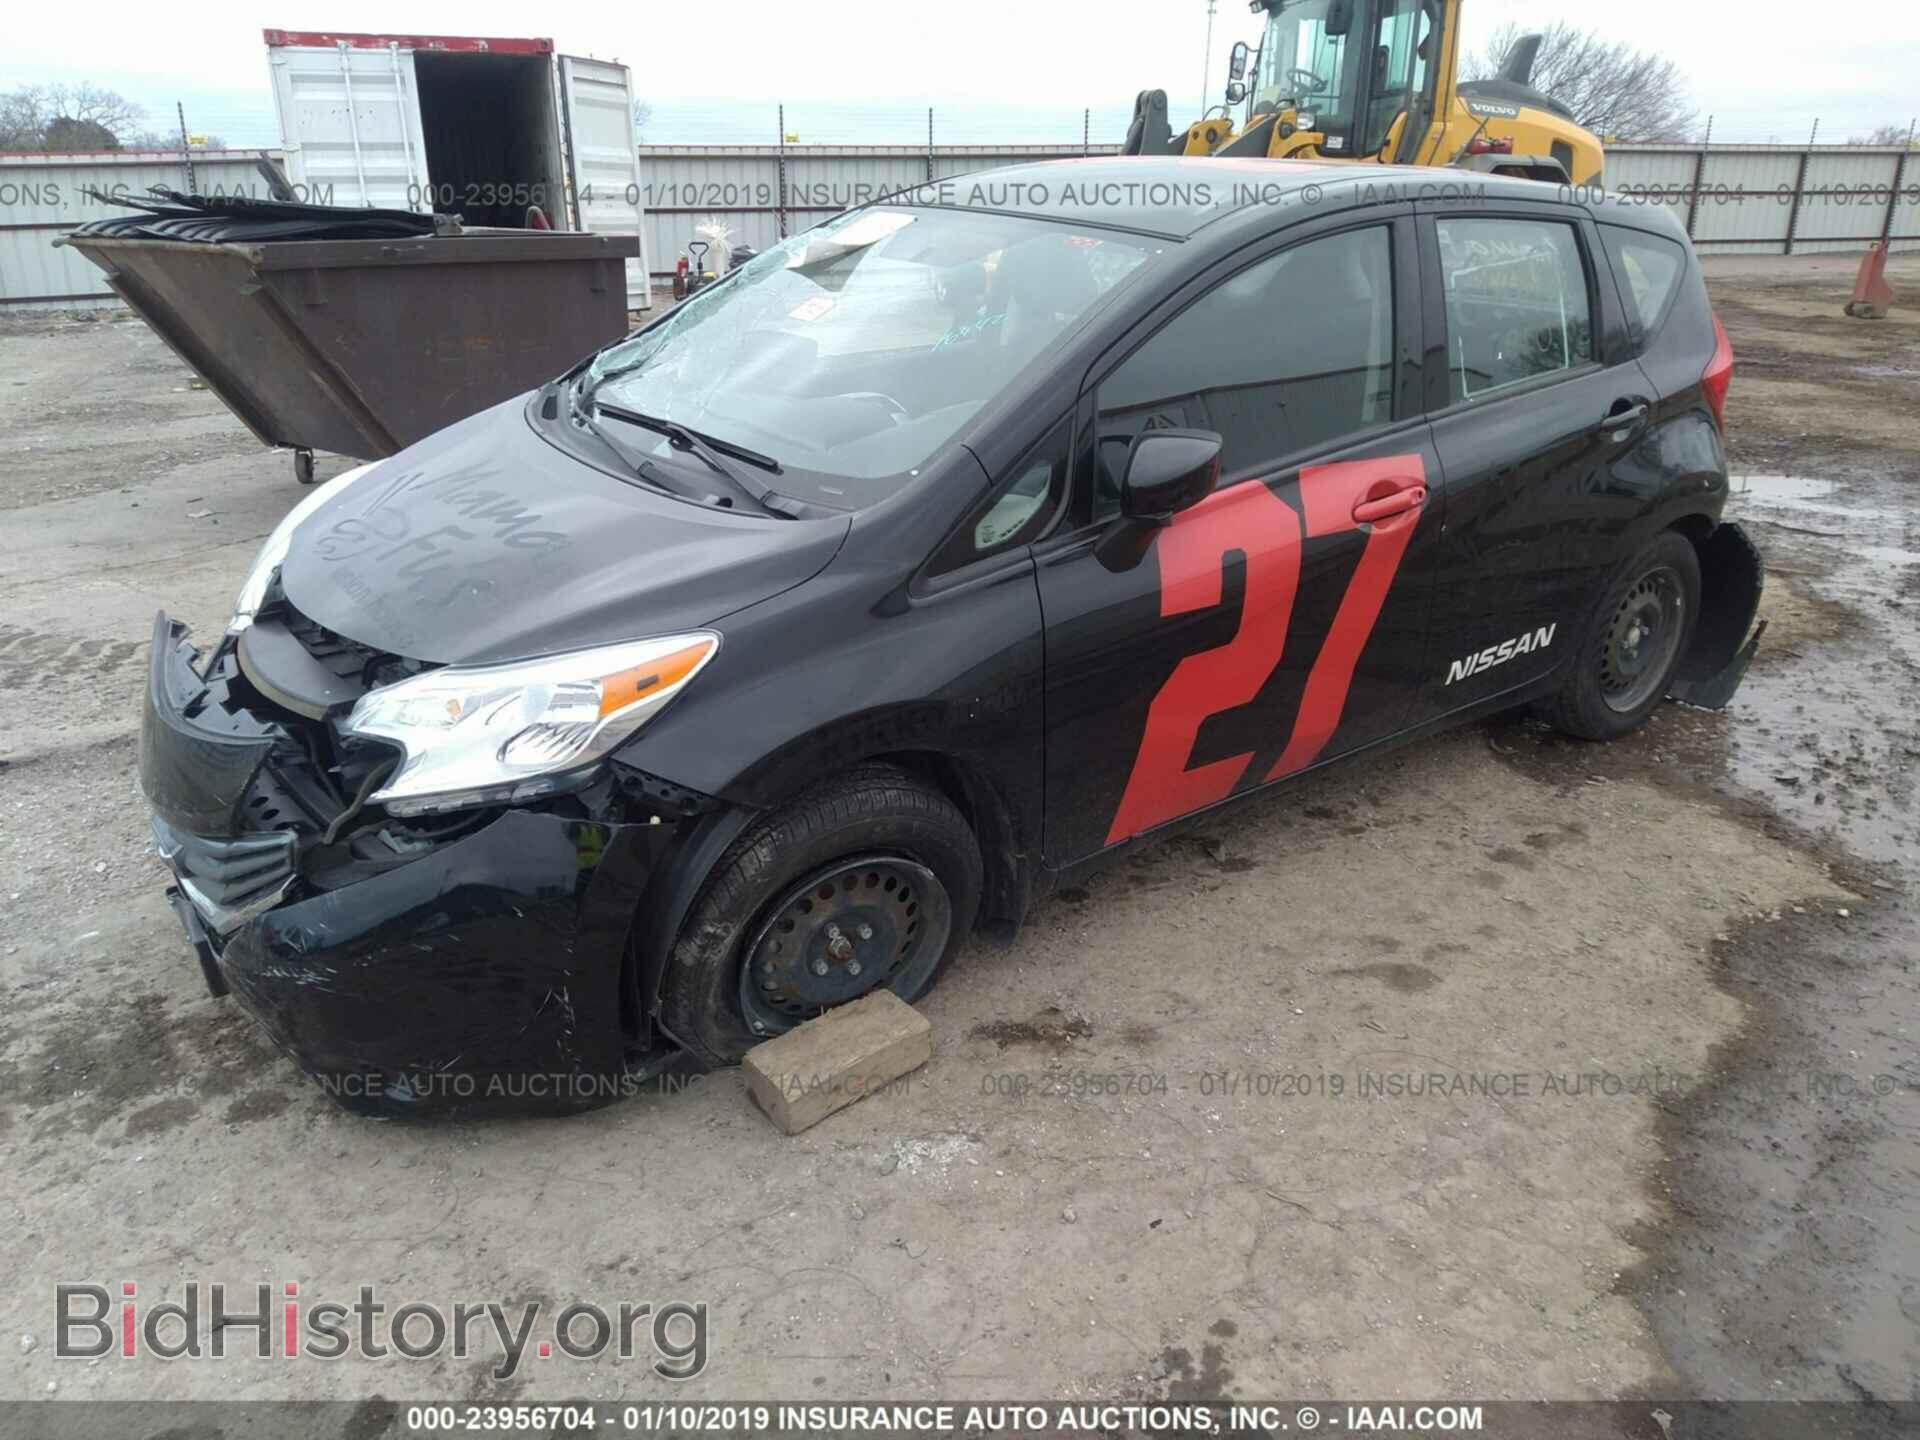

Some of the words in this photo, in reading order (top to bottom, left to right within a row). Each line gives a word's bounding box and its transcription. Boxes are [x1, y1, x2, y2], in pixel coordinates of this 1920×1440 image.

[1471, 103, 1517, 116] VOLVO
[1104, 454, 1428, 848] 27
[1445, 622, 1557, 686] NISSAN
